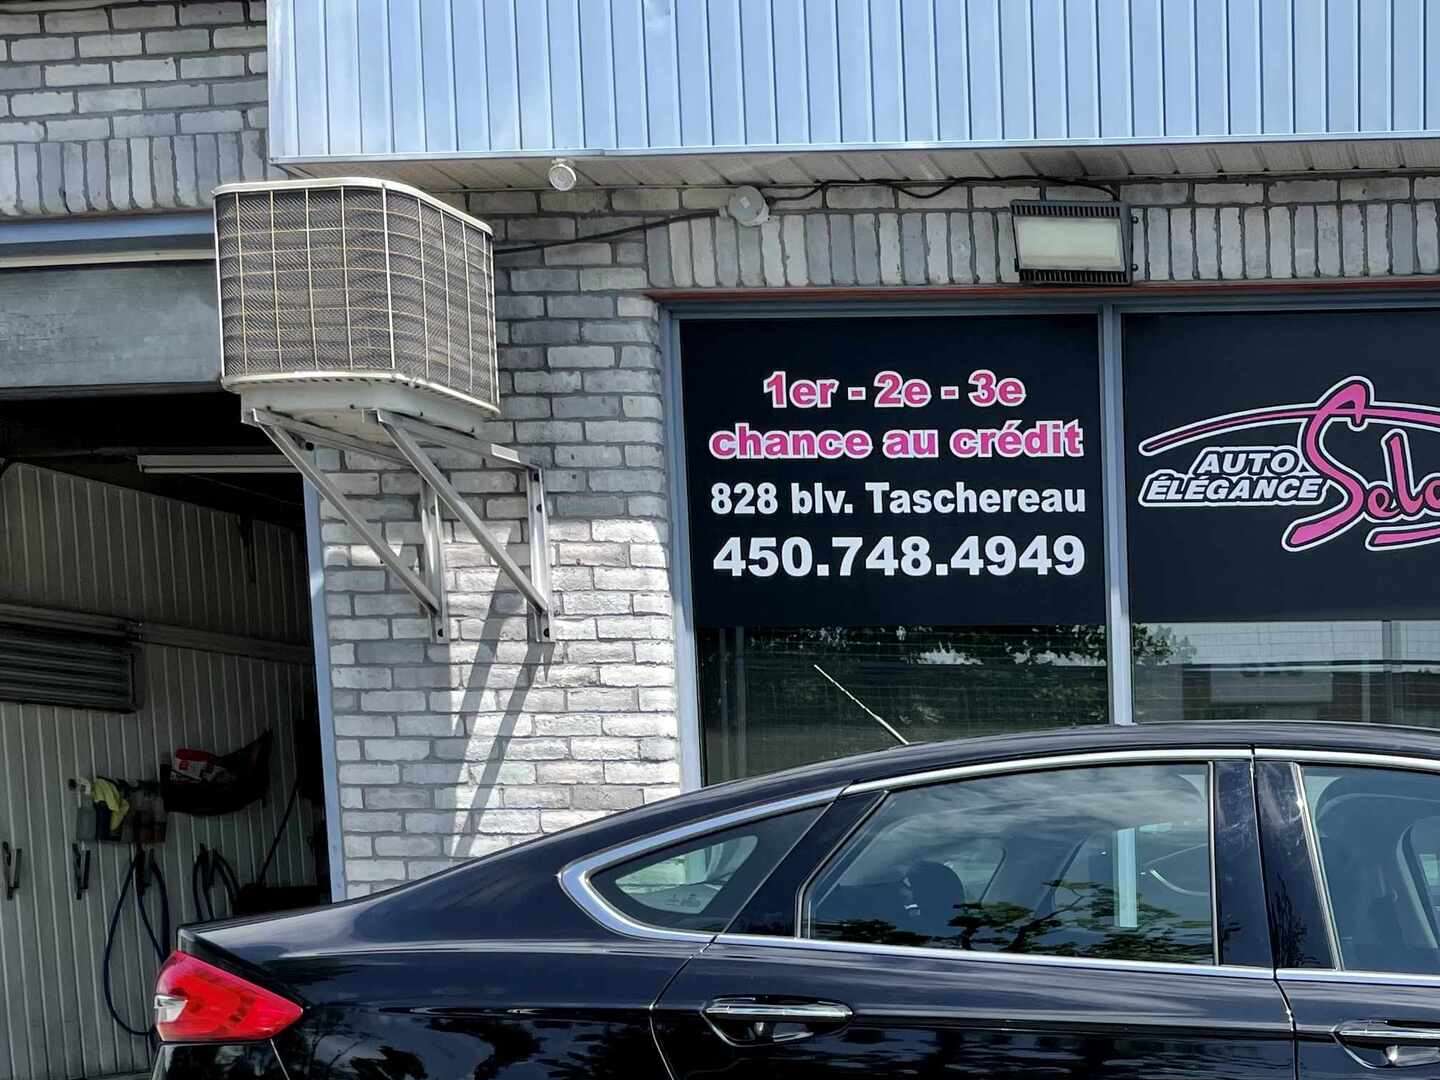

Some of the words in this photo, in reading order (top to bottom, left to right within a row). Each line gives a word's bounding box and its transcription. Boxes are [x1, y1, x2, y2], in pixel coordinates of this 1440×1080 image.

[764, 371, 839, 409] 1er
[874, 370, 932, 409] 2e
[968, 369, 1026, 407] 3e
[709, 423, 873, 459] chance
[882, 430, 940, 459] au
[950, 419, 1085, 458] crédit
[1198, 451, 1301, 476] AUTO
[710, 482, 779, 515] 828
[791, 482, 854, 515] blv.
[865, 481, 1086, 515] Taschereau
[1145, 474, 1323, 501] ÉLÉGANCE
[712, 535, 1086, 577] 450.748.4949
